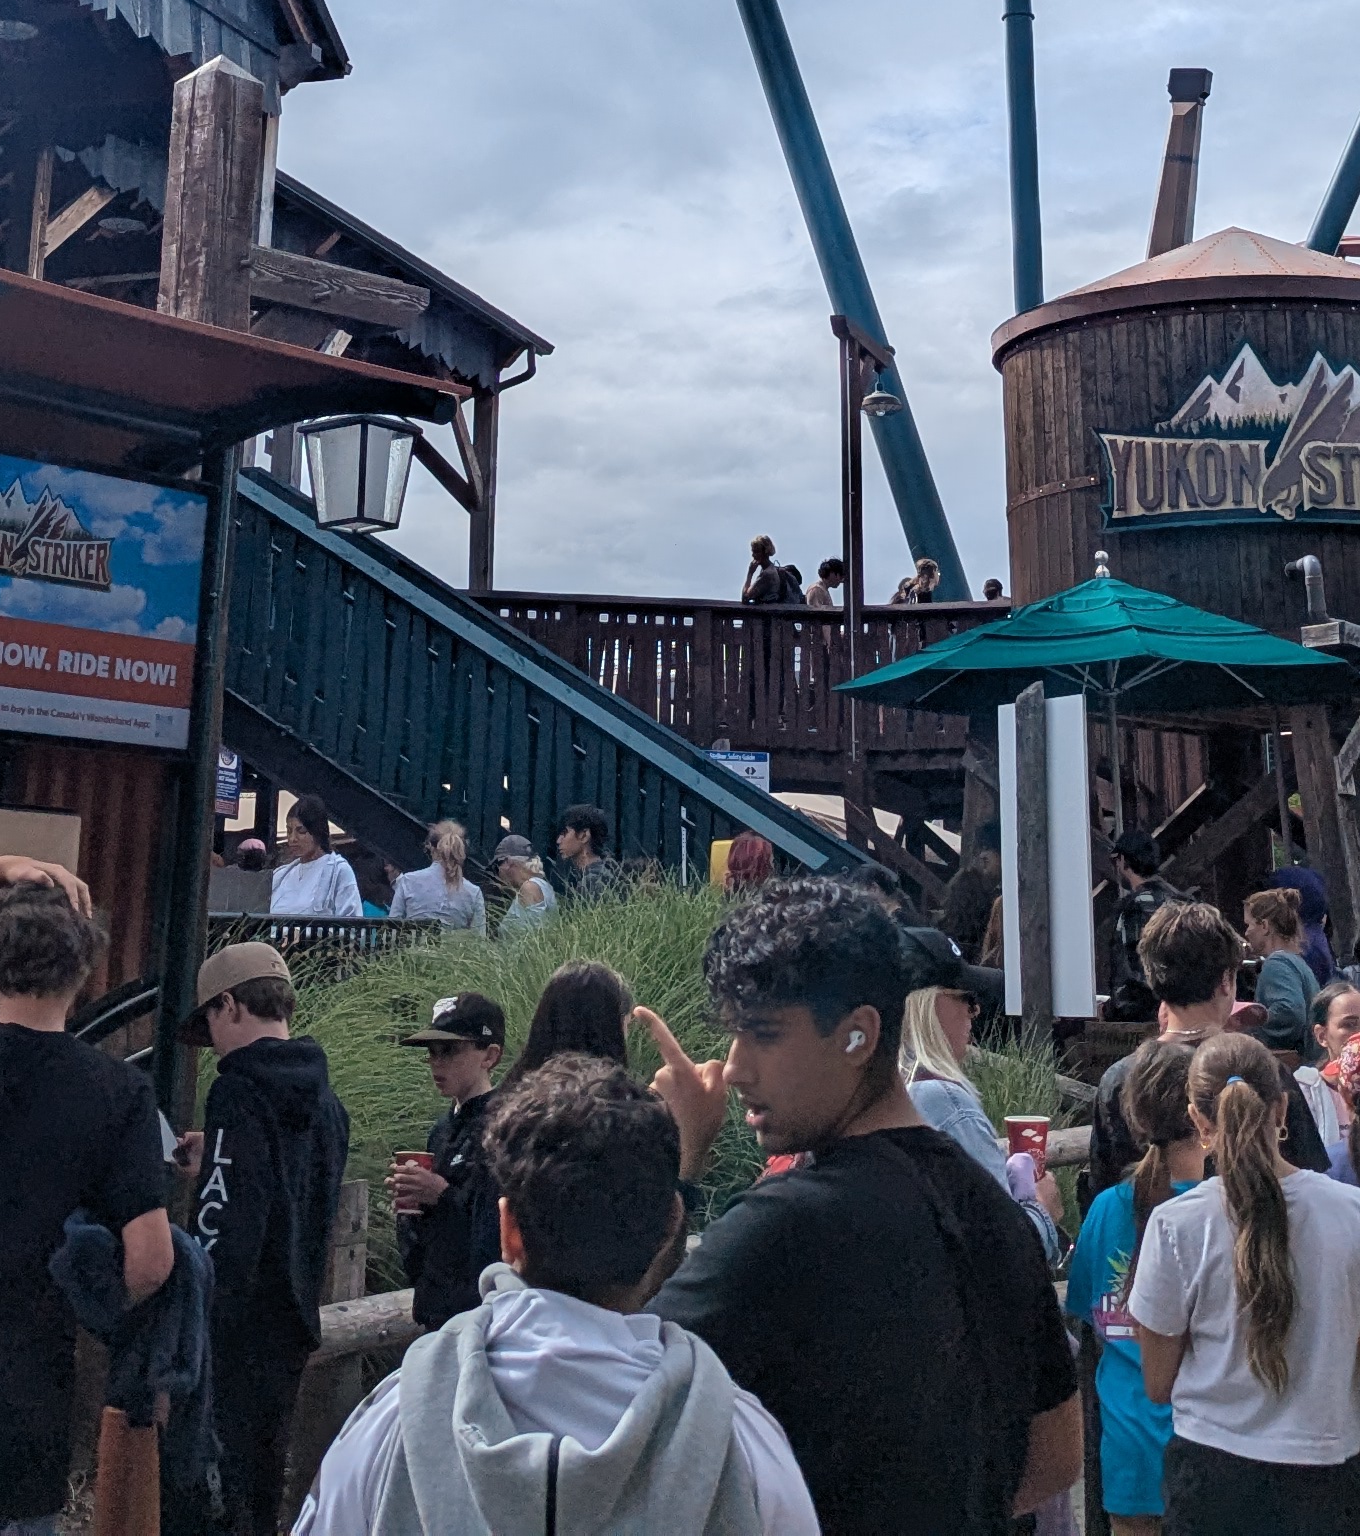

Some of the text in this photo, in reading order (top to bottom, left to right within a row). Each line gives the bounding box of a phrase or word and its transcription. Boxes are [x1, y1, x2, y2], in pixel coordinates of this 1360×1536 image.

[1108, 438, 1263, 513] YUKON
[29, 539, 109, 584] STRIKER
[57, 649, 111, 678] RIDE
[113, 657, 178, 688] NOW!
